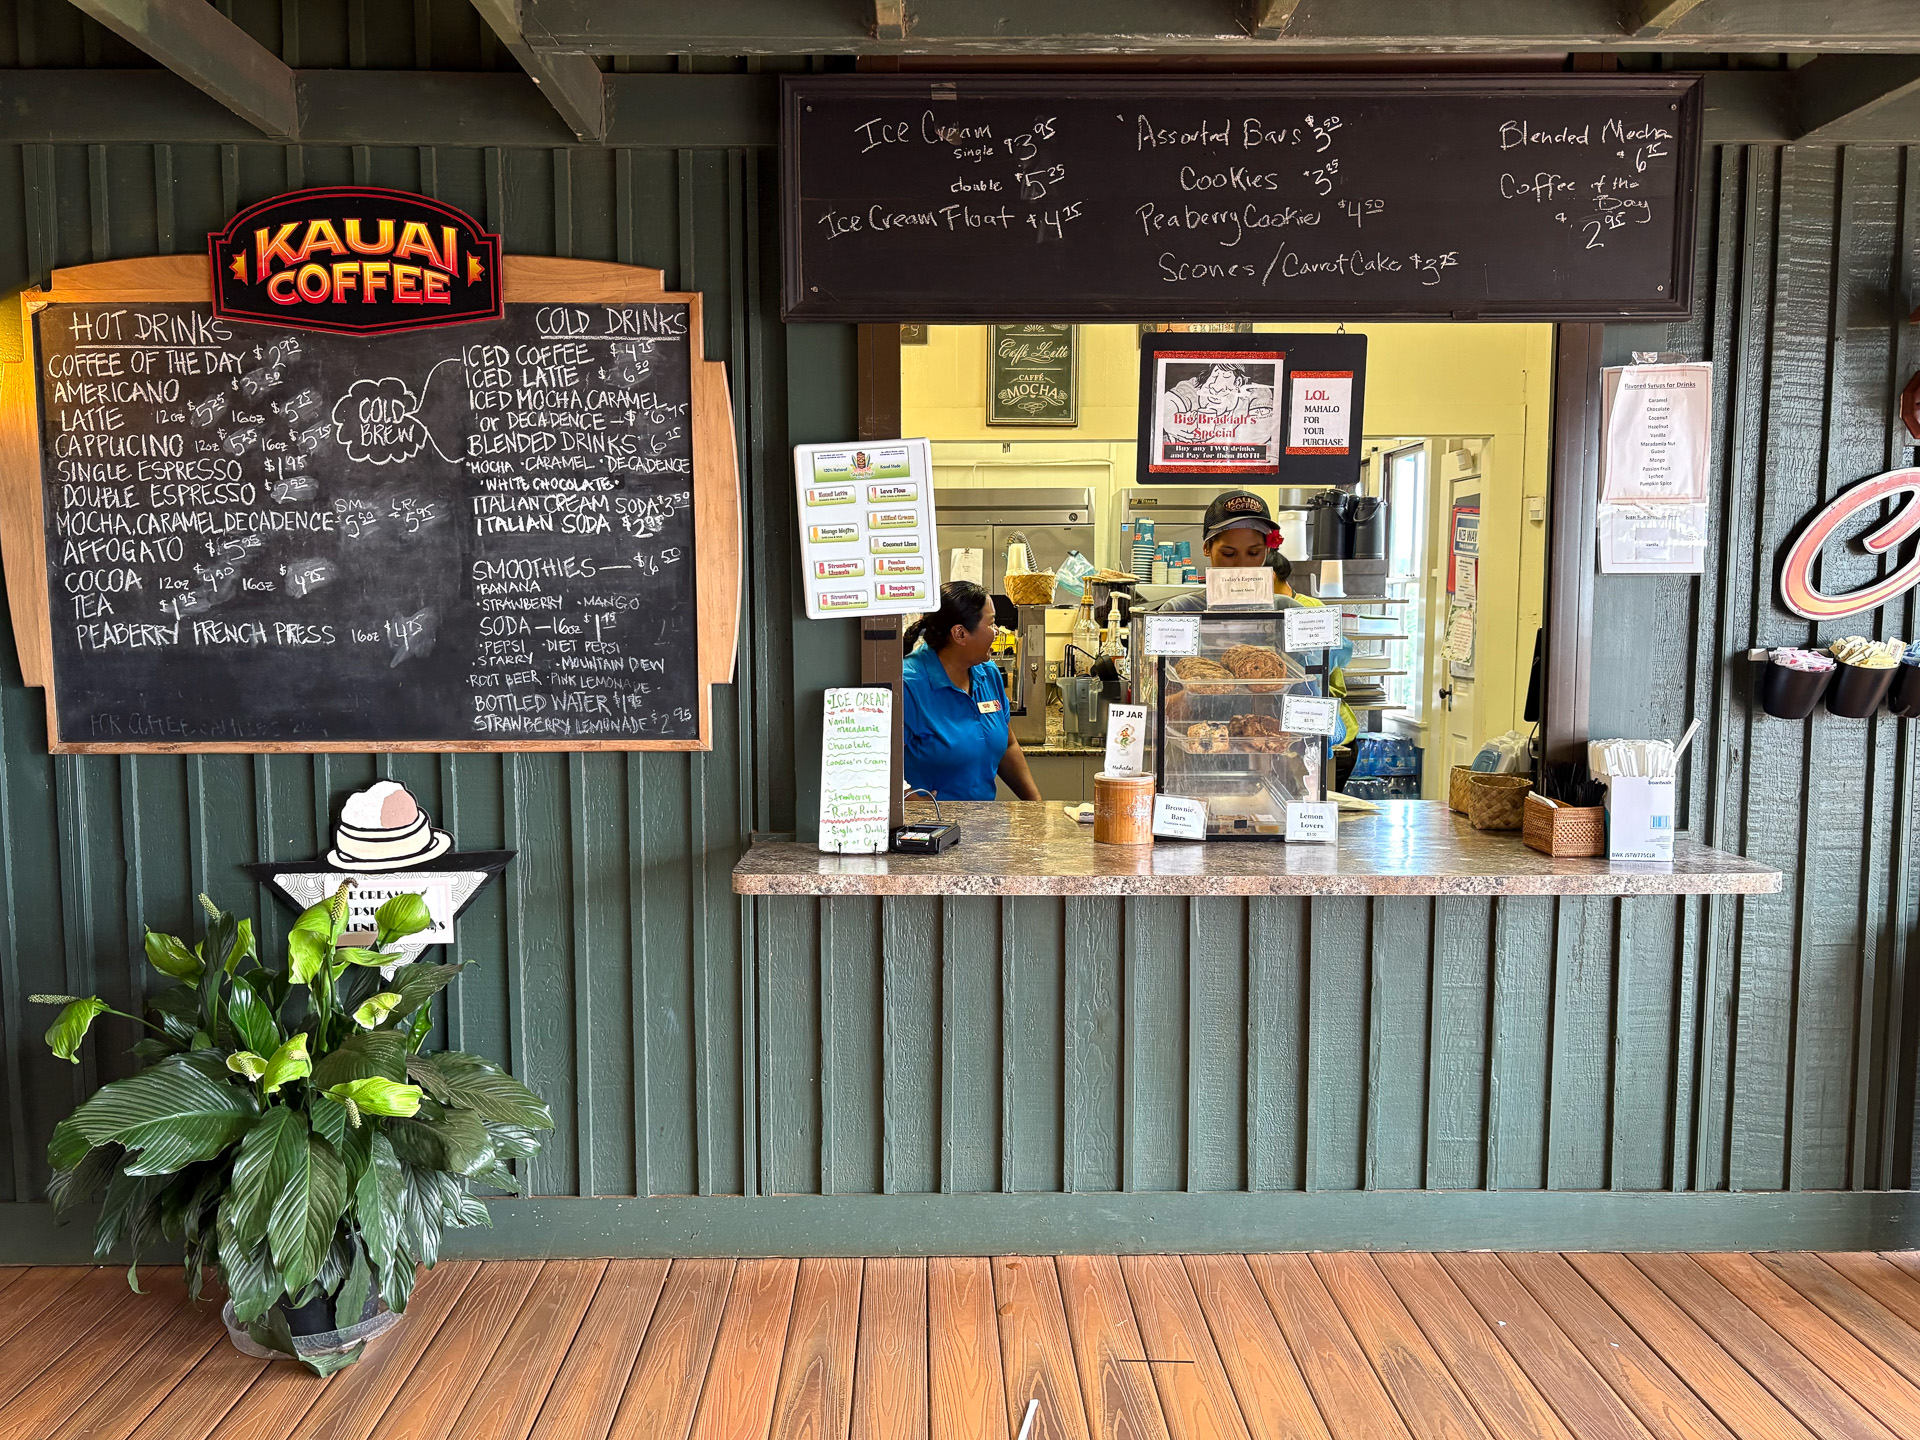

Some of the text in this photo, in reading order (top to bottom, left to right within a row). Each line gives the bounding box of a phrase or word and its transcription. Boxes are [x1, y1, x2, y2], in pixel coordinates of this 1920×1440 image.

[854, 109, 993, 154] Ice Cream
[1136, 114, 1303, 151] Assorted Bars
[1499, 119, 1590, 151] Blended
[953, 144, 995, 163] single
[950, 175, 1004, 194] double
[1180, 165, 1280, 192] Cookies
[1500, 171, 1576, 203] Coffee
[1592, 194, 1652, 225] Day
[818, 203, 1016, 241] Ice Cream Float
[1135, 201, 1322, 248] Peaberry Cookie
[254, 217, 461, 286] KAUAI
[1157, 251, 1257, 283] Scones
[1350, 250, 1403, 278] Cake
[266, 259, 452, 306] COFFEE
[68, 309, 233, 346] HOT DRINKS
[535, 306, 688, 335] COLD DRINKS
[48, 349, 247, 378] COFFEE OF THE DAY
[462, 342, 596, 368] ICED COFFEE
[465, 365, 580, 389] ICED LATTE
[53, 377, 181, 405] AMERICANO
[469, 389, 513, 411] ICED
[1006, 383, 1060, 401] MOCHA
[1304, 389, 1330, 401] LOL
[60, 406, 266, 433] LATTE 12oz 16oz
[358, 396, 406, 424] COLD
[1173, 413, 1197, 426] Big
[1303, 415, 1320, 424] FOR
[1304, 405, 1340, 414] MAHALO
[479, 417, 500, 433] or
[506, 411, 606, 431] DECADENCE
[1303, 427, 1325, 436] YOUR
[360, 423, 415, 447] BREW
[466, 430, 637, 457] BLENDED DRINKS
[1193, 427, 1237, 440] Special
[1302, 438, 1344, 446] PURCHASE
[54, 433, 289, 459] CAPPUCINO 12oz 16oz
[1175, 445, 1191, 453] Buy
[1186, 452, 1201, 460] Pay
[57, 457, 243, 483] SINGLE ESPRESSO
[524, 456, 596, 472] CARAMEL
[606, 456, 691, 474] DECADENCE
[485, 476, 615, 492] WHITE CHOCOLATE
[63, 482, 256, 509] DOUBLE ESPRESSO
[472, 494, 660, 516] ITALIAN CREAM SODA
[476, 513, 612, 537] ITALIAN SODA
[62, 535, 184, 566] AFFOGATO
[472, 556, 597, 582] SMOOTHIES
[64, 567, 277, 594] COCOA 12oz 16oz
[480, 579, 541, 596] BANANA
[70, 592, 115, 620] TEA
[482, 595, 641, 612] STRAWBERRY MANGO
[76, 619, 381, 651] PEABERRY FRENCH PRESS 16oz
[479, 615, 533, 637] SODA
[484, 639, 621, 655] PEPSI DIET PEPSI
[478, 651, 534, 667] STARRY
[561, 656, 666, 675] MOUNTAIN DEW
[470, 669, 543, 688] ROOT BEER
[550, 672, 652, 695] PINK LEMONADE
[474, 690, 612, 716] BOTTLED WATER
[829, 691, 852, 709] ICE
[473, 714, 648, 736] STRAWBERRY LEMONADE
[828, 716, 856, 727] Vanilla
[1111, 709, 1144, 719] TIP JAR
[827, 740, 872, 751] Chocolate
[1171, 813, 1187, 822] Bars
[1299, 812, 1324, 821] Lemon
[1300, 821, 1325, 830] Lovers
